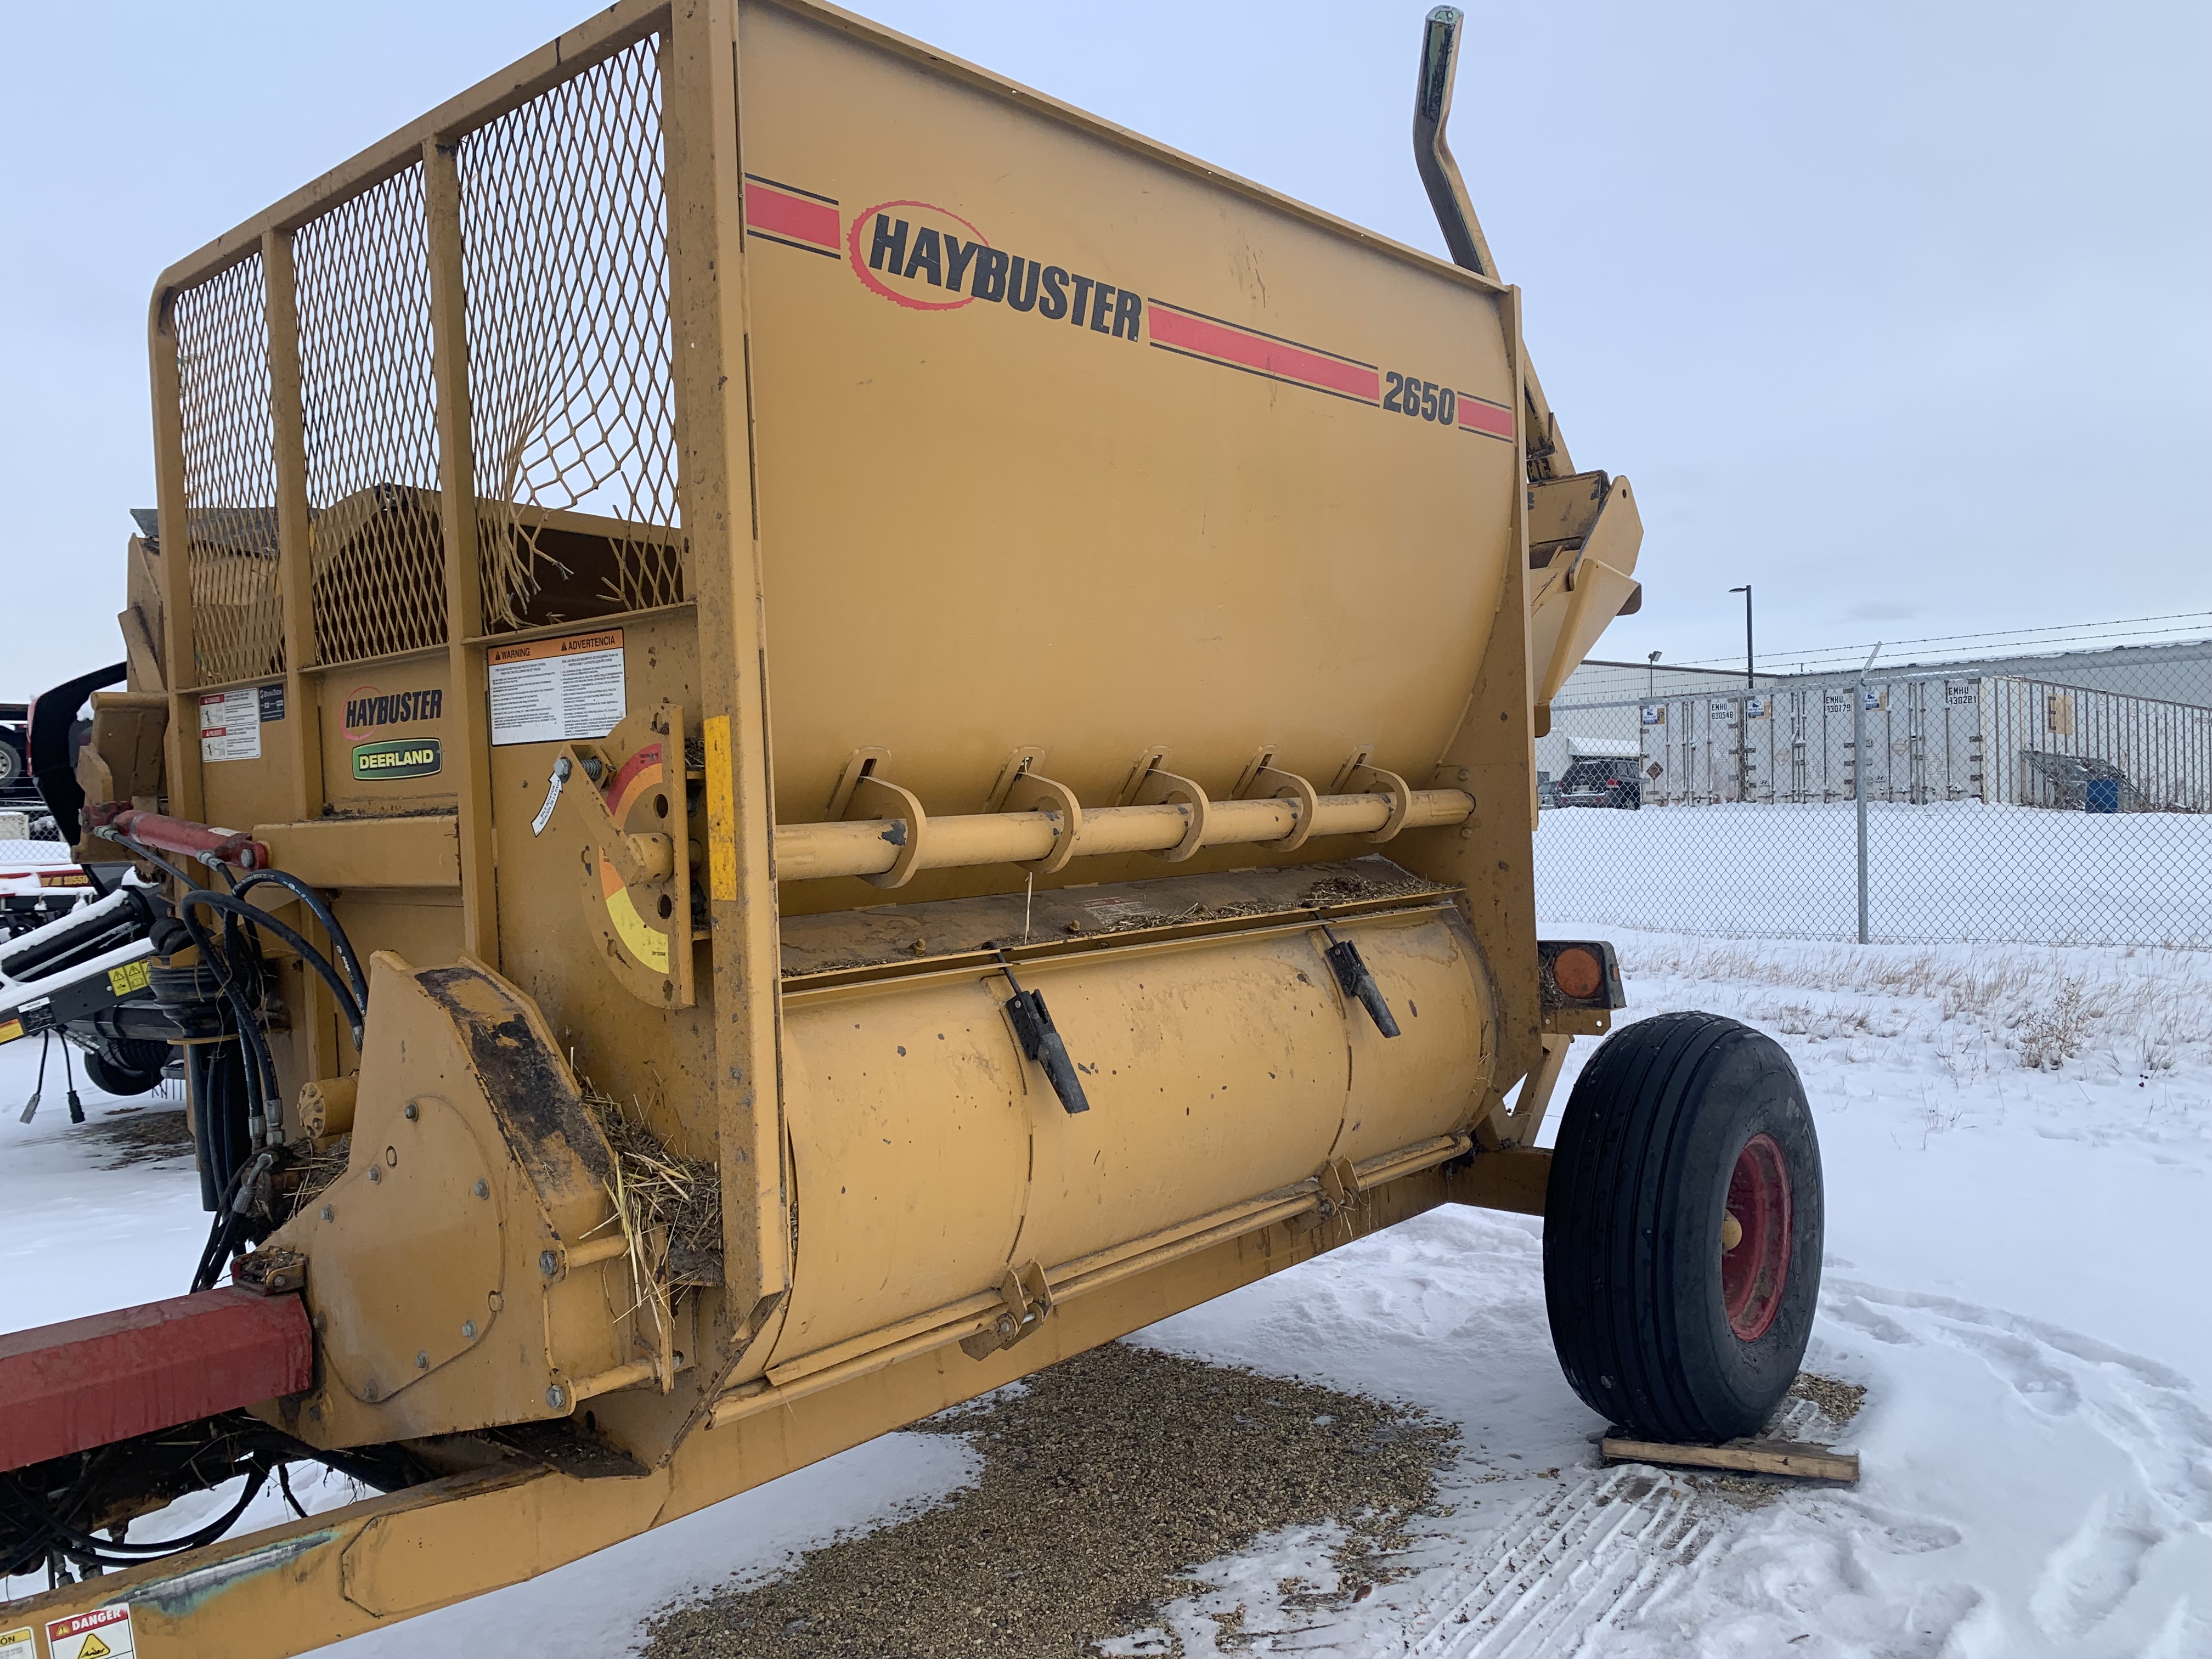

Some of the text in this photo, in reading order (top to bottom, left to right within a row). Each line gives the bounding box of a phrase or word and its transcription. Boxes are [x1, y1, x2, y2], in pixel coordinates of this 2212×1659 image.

[868, 213, 1142, 342] HAYBUSTER
[1383, 371, 1455, 425] 2650
[501, 648, 530, 660] WARNING
[568, 635, 615, 651] ADVERTENCIA
[1949, 686, 1968, 695] EMHU
[346, 689, 442, 728] HAYBUSTER
[359, 749, 434, 770] DEERLAND
[546, 785, 555, 808] ROTATION
[71, 1609, 121, 1632] DANGER
